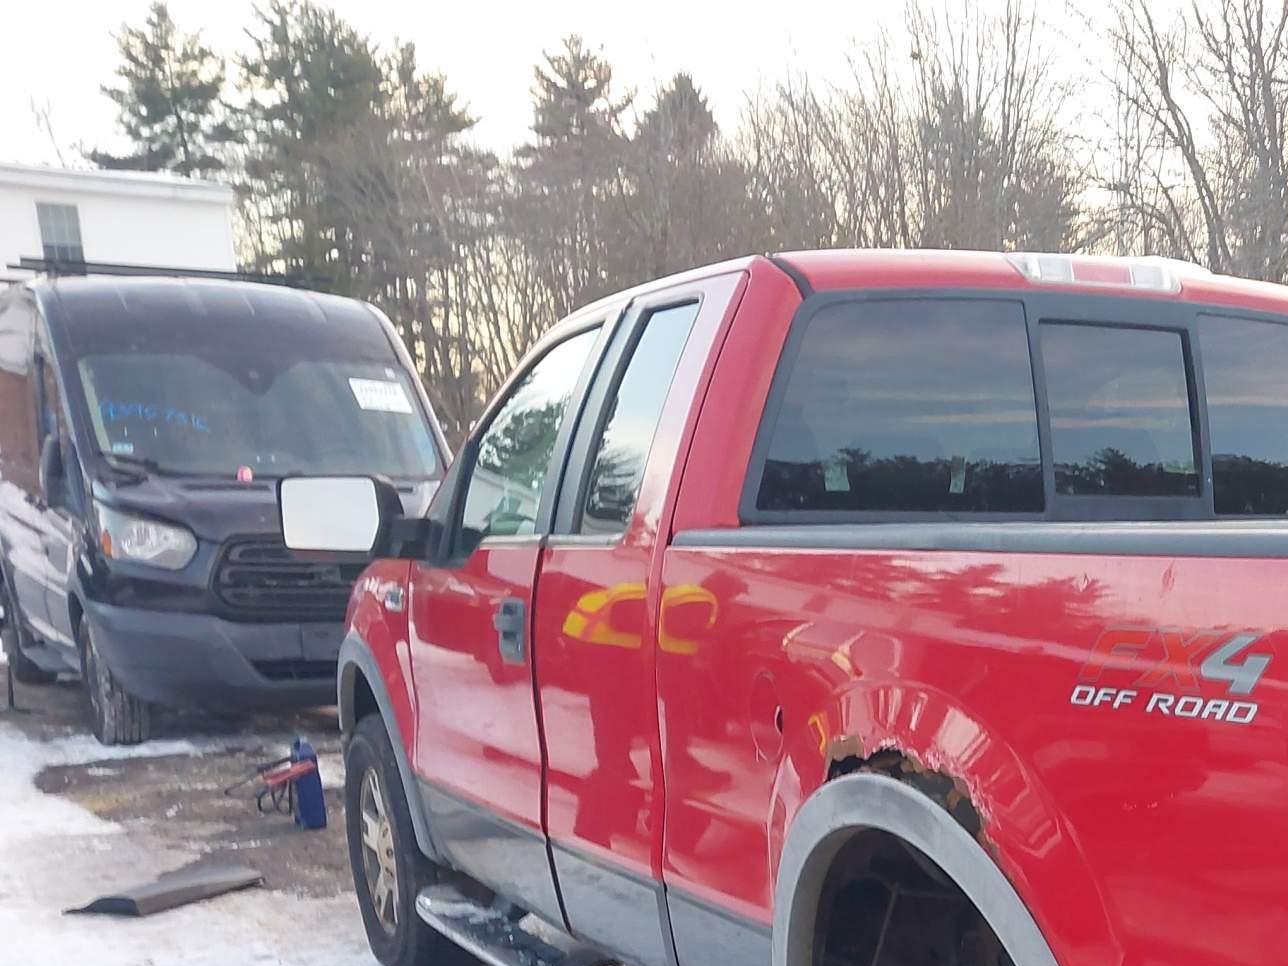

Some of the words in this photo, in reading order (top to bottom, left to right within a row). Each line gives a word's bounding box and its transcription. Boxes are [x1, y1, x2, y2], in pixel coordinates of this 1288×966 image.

[1077, 625, 1273, 694] FX4
[1070, 685, 1137, 709] OFF
[1146, 692, 1258, 724] ROAD
